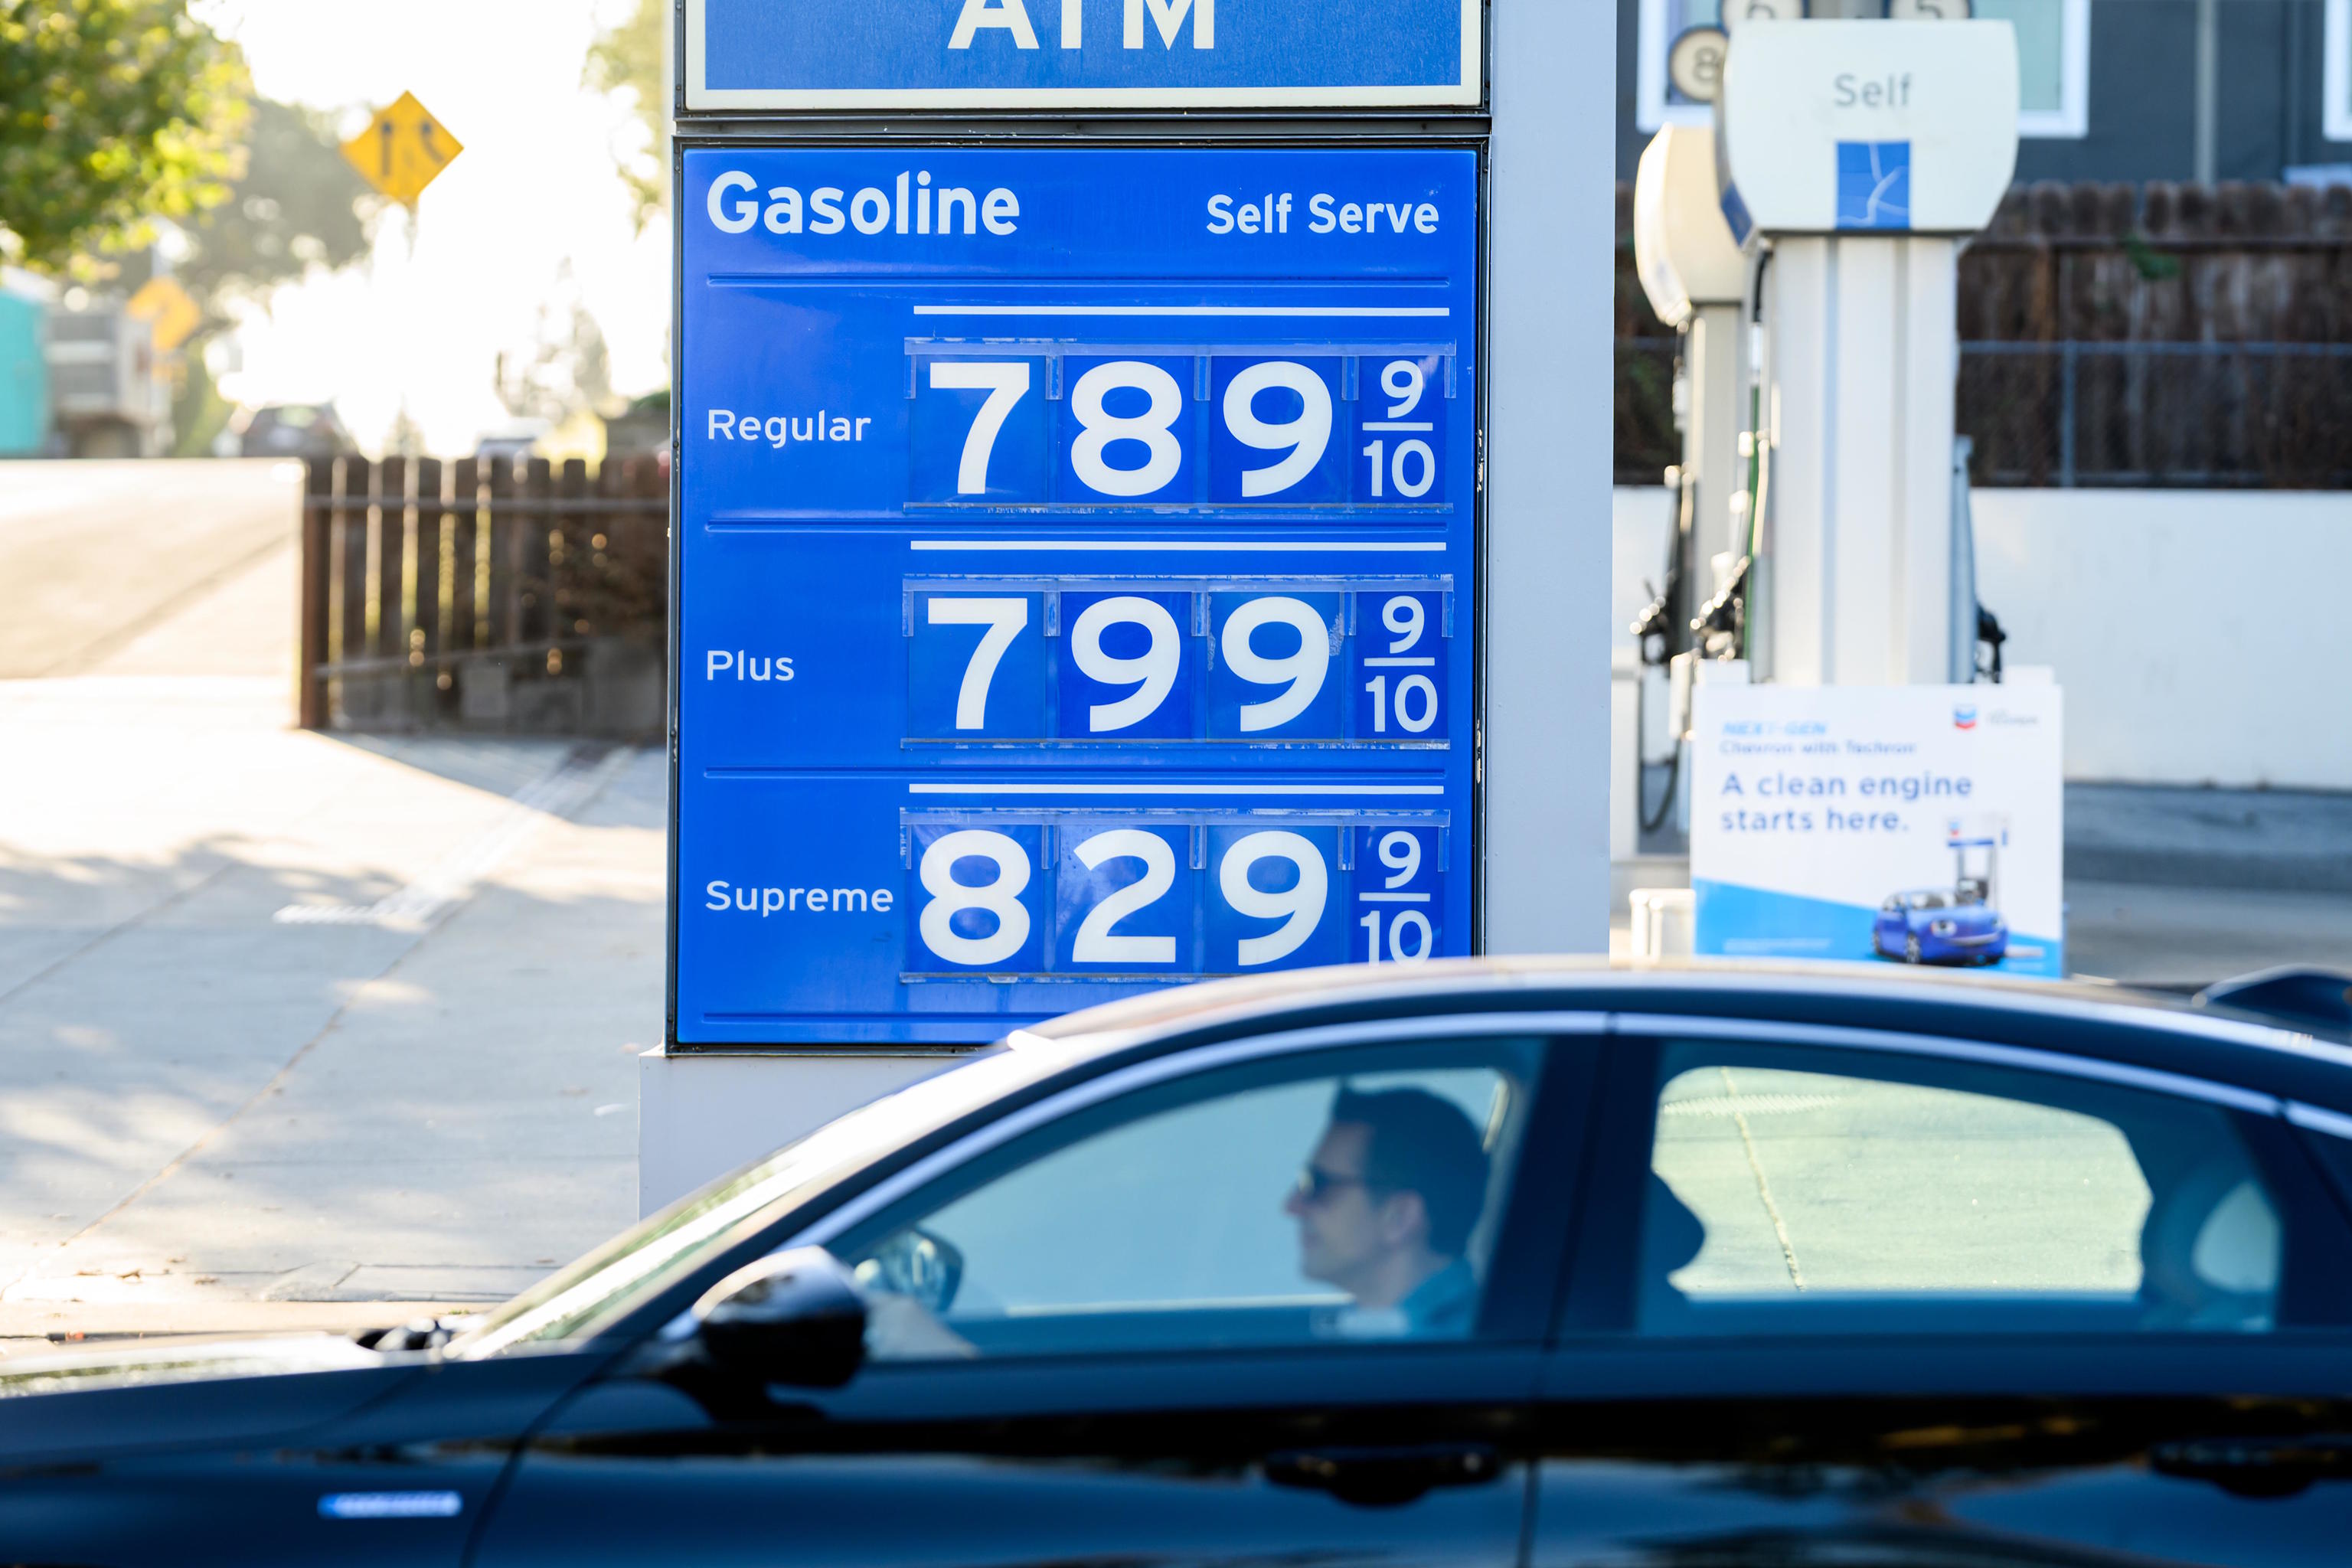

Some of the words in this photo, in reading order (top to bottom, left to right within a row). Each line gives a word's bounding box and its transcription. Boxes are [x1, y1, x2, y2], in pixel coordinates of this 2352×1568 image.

[1834, 74, 1911, 106] Self
[707, 170, 1020, 235] Gasoline
[1206, 193, 1292, 234] Self
[1308, 193, 1439, 234] Serve
[707, 409, 871, 449] Regular
[929, 361, 1333, 497] 789
[707, 650, 795, 681] Plus
[927, 596, 1330, 732] 799
[1802, 739, 1838, 754] with
[1722, 771, 1744, 795] A
[1758, 770, 1846, 795] clean
[1859, 770, 1973, 801] engine
[1721, 808, 1813, 831] starts
[1827, 806, 1909, 831] here.
[706, 880, 893, 917] Supreme
[920, 828, 1328, 965] 829
